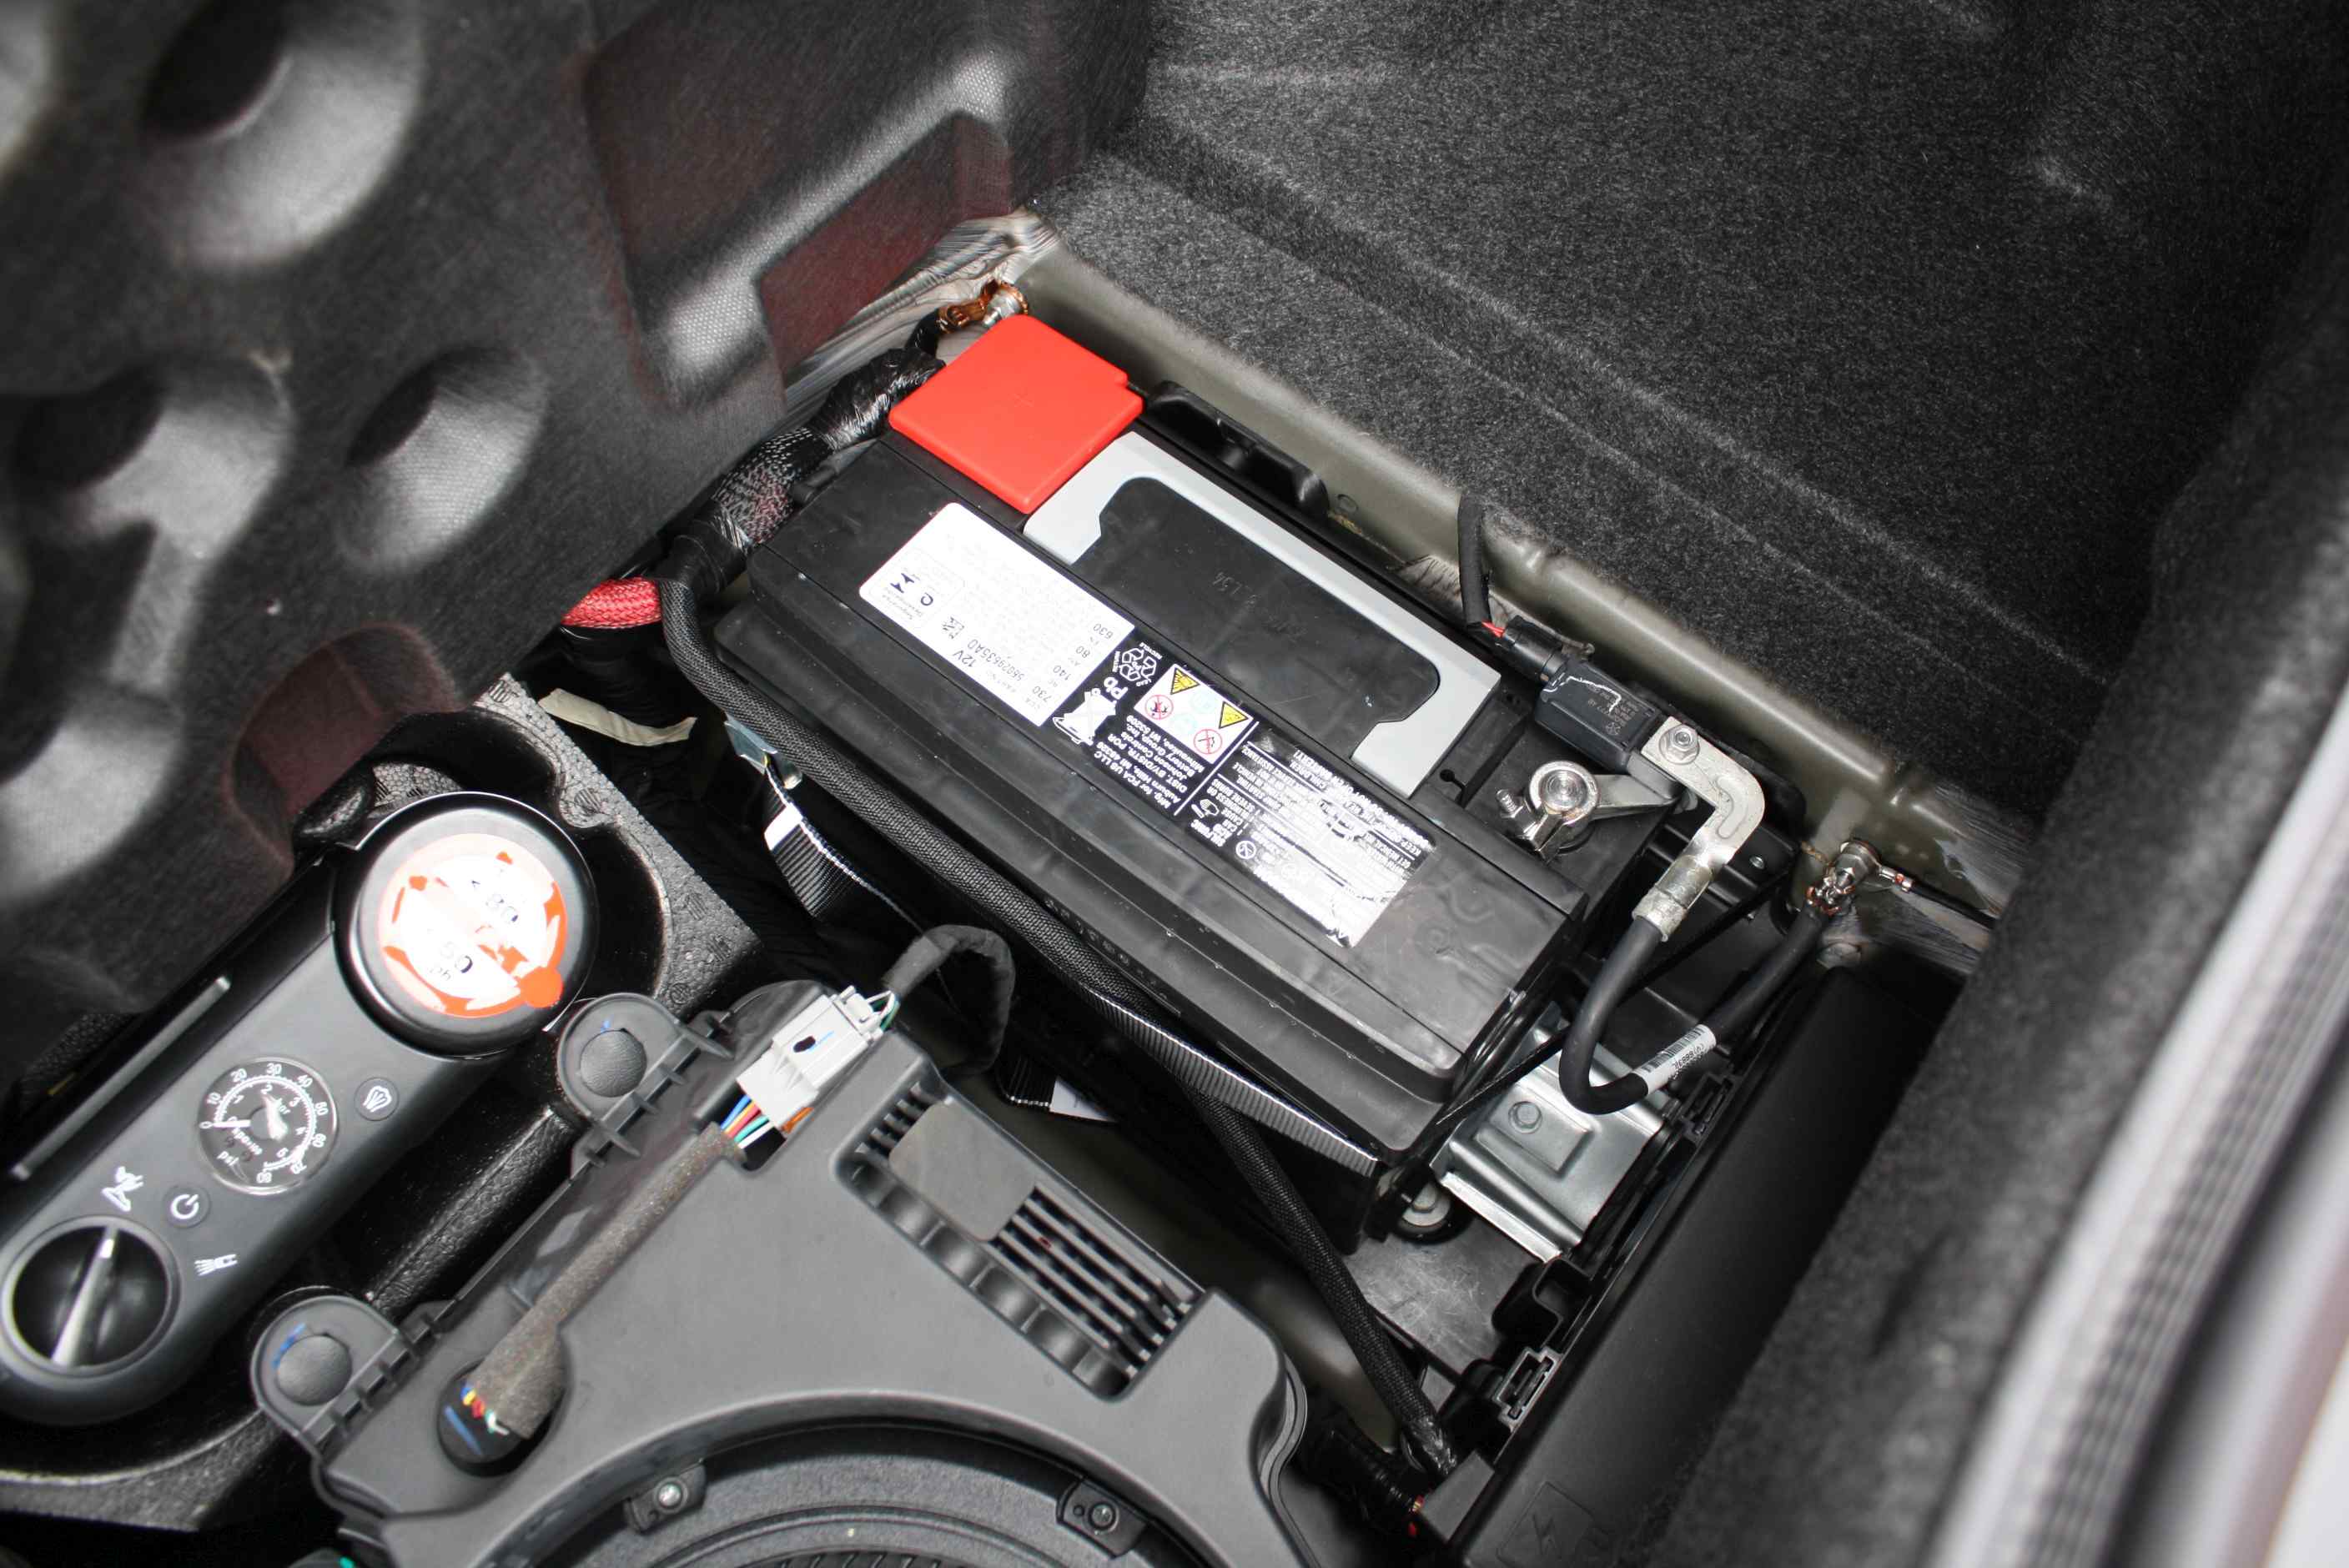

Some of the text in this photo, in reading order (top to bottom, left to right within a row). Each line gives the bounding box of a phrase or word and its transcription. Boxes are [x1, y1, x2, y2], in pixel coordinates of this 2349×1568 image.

[1091, 621, 1114, 641] 630
[951, 646, 978, 668] 12V
[1074, 644, 1091, 659] 80
[1138, 641, 1163, 660] RECYCLE
[1050, 663, 1073, 681] 140
[1029, 684, 1053, 703] 730
[1099, 674, 1129, 701] Pb
[1122, 722, 1197, 777] Battery Group, Inc.
[1124, 713, 1206, 773] Milwaukee, WI 53209
[1106, 732, 1189, 794] DIST. BY/DISTR. POR
[1118, 730, 1188, 782] Johnson Controls
[1292, 749, 1333, 781] BATTERY!
[1092, 749, 1173, 809] Mfg. for FCA US LLC
[1095, 740, 1181, 804] Auburn Hills, MI 48326
[1232, 761, 1257, 781] VEHICLE
[1271, 767, 1295, 787] SERVICE
[1287, 758, 1327, 789] CHILDREN.
[1210, 777, 1255, 812] SEVERE BURNS
[1214, 792, 1250, 820] BLINDNESS
[1220, 807, 1244, 826] CAUSE
[1220, 817, 1238, 832] CAN
[1189, 817, 1227, 847] SULFURIC
[1211, 822, 1233, 840] ACID
[1372, 839, 1400, 861] MEDICAL
[1400, 838, 1421, 857] KEEP
[1397, 857, 1411, 869] GET
[230, 1068, 248, 1083] 20
[266, 1063, 282, 1074] 30
[260, 1084, 272, 1094] 2
[296, 1073, 313, 1088] 40
[206, 1092, 221, 1104] 10
[289, 1097, 299, 1108] 3
[216, 1150, 239, 1166] psi
[289, 1161, 307, 1174] 70
[256, 1172, 272, 1183] 80
